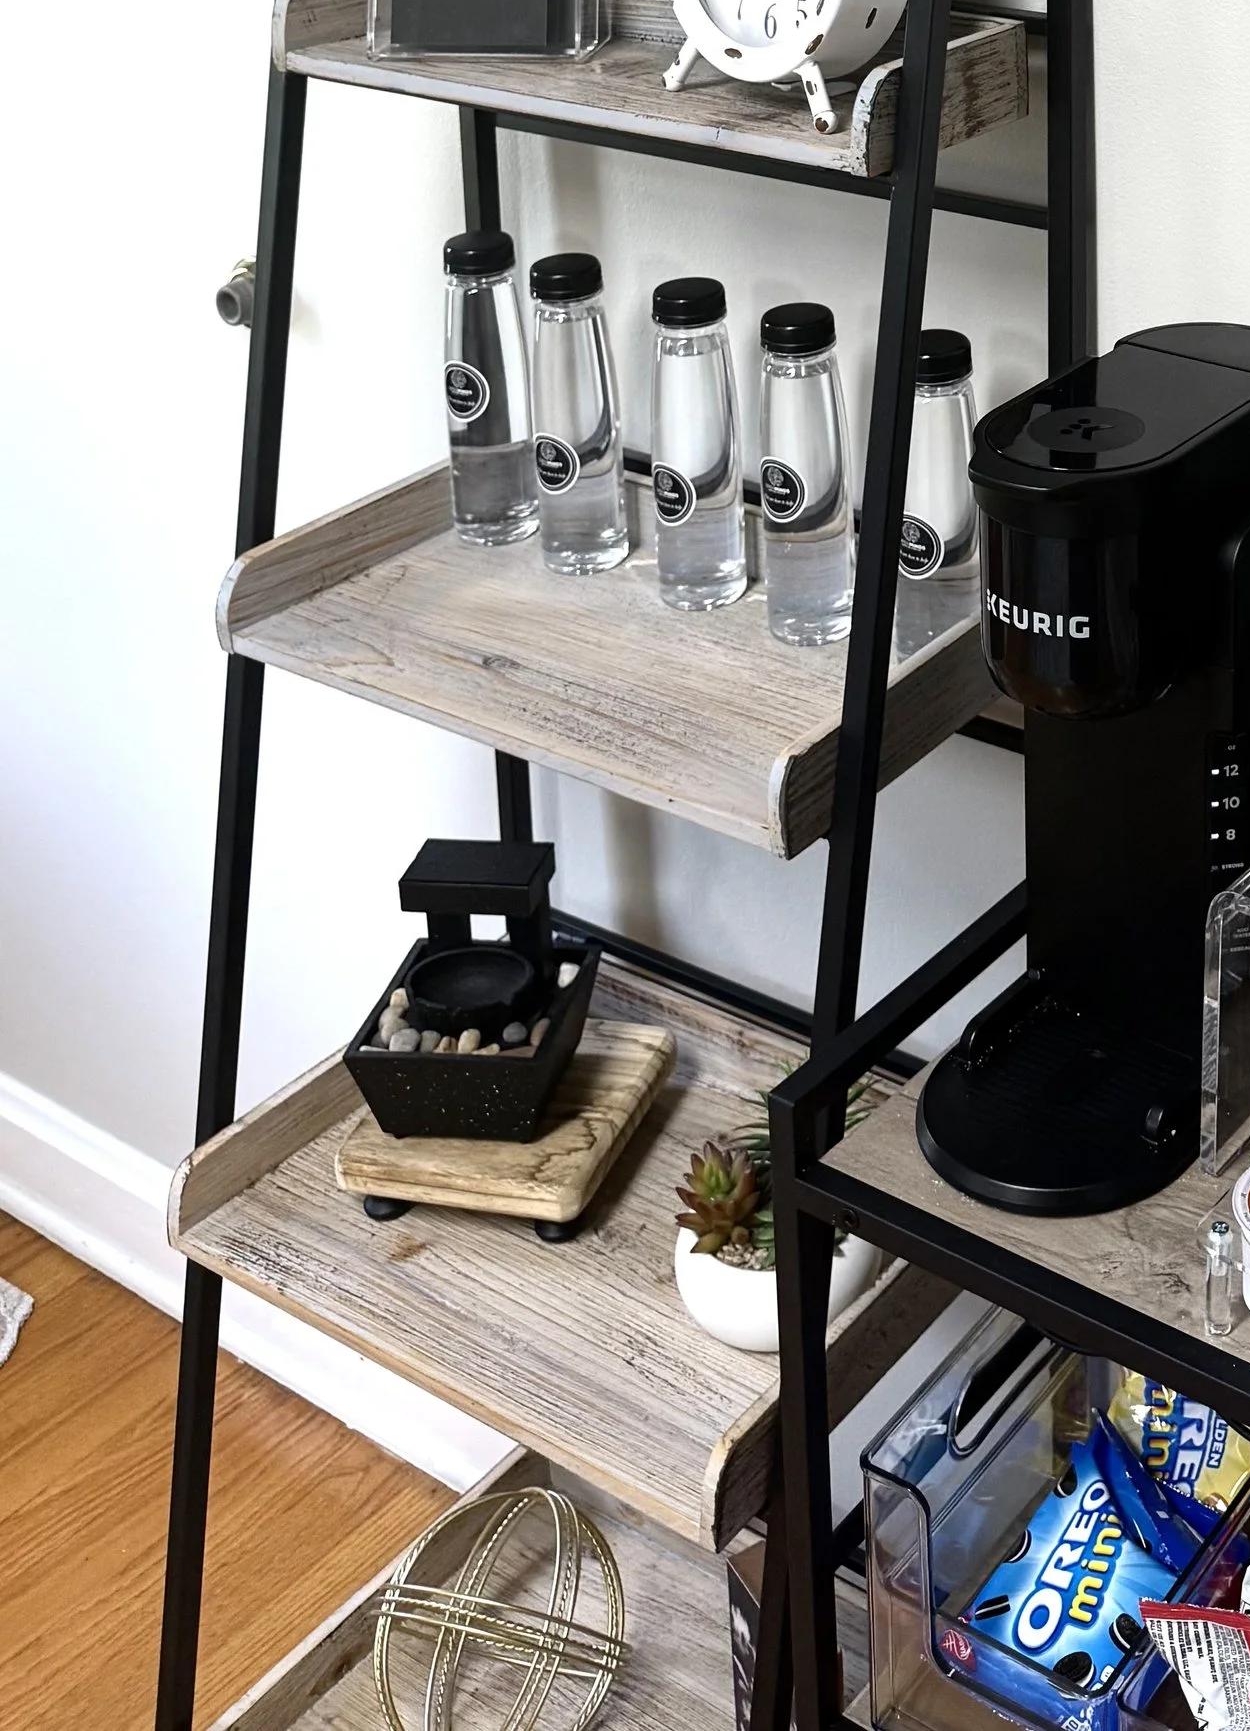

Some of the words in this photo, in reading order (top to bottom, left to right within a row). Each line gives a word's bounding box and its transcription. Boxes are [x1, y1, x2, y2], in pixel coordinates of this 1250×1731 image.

[764, 3, 777, 39] 6
[986, 588, 1090, 639] KEURIG
[1224, 764, 1239, 777] 12
[1222, 796, 1240, 809] 10
[1226, 829, 1236, 840] 8
[1017, 1480, 1108, 1650] OREO
[1068, 1513, 1123, 1623] mini
